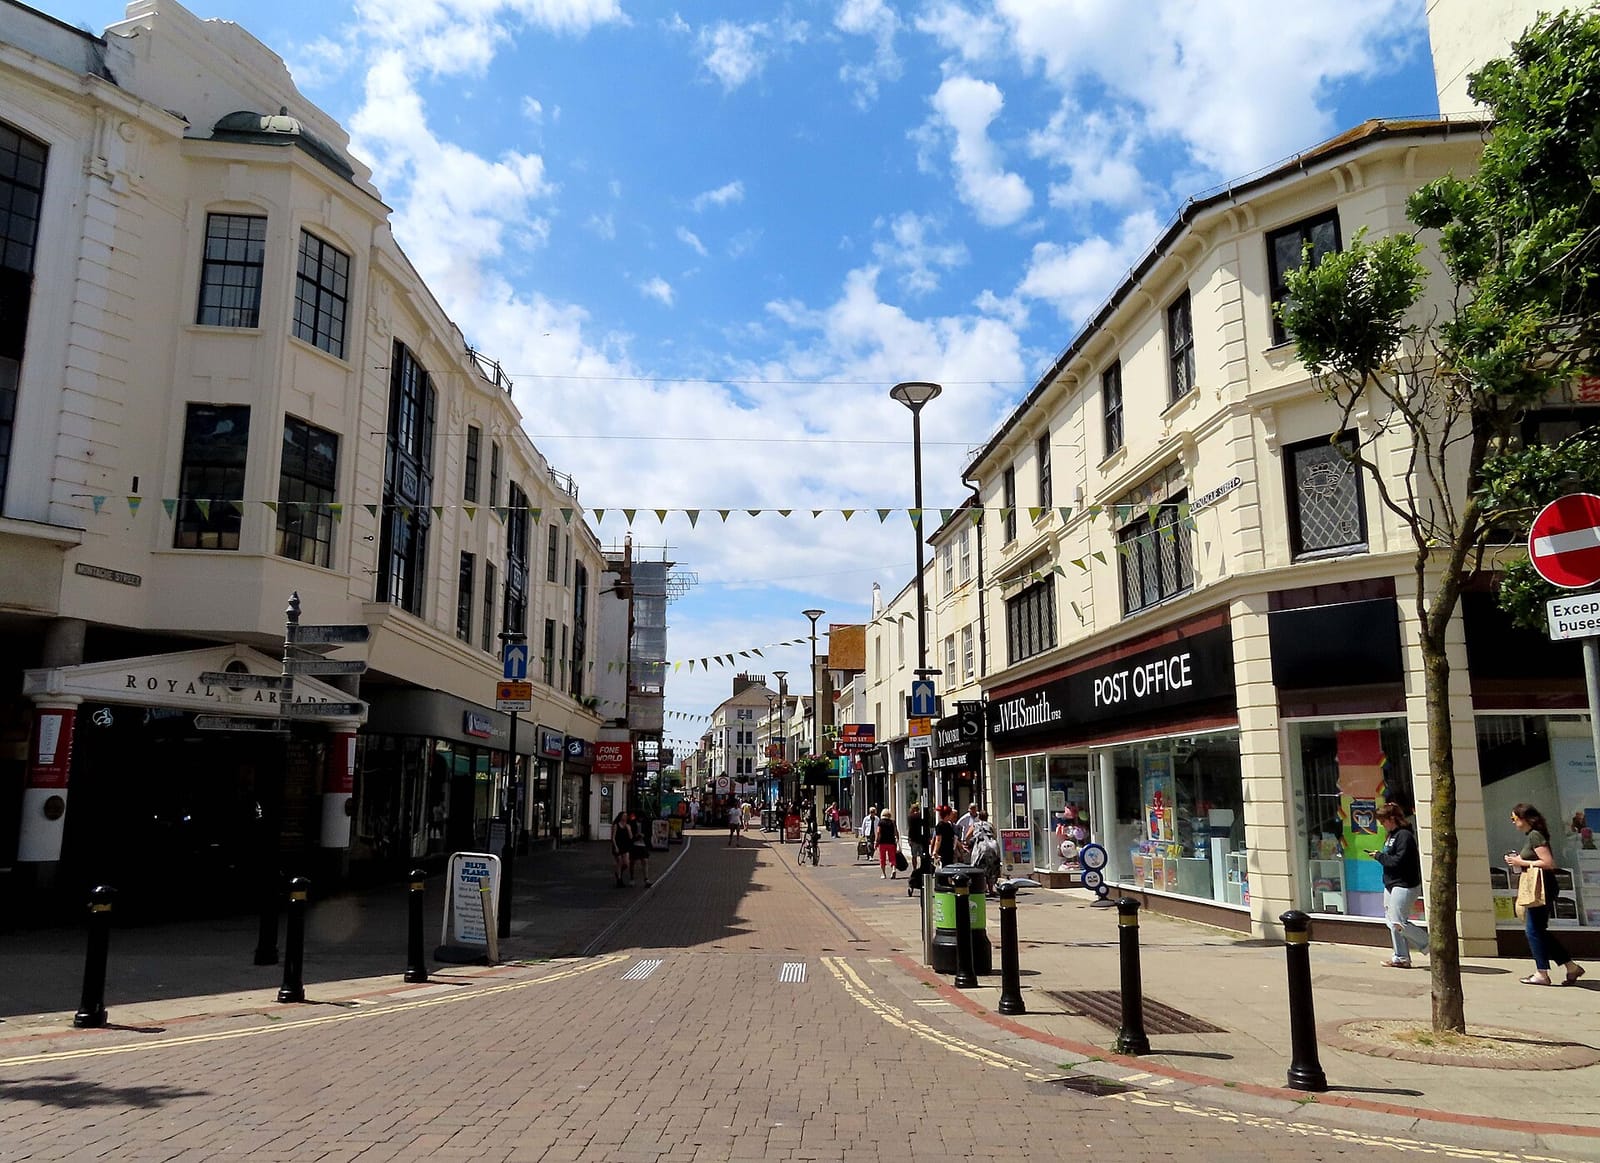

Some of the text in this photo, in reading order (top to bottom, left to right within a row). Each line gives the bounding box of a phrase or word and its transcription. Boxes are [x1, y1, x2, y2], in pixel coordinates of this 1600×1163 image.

[1553, 602, 1600, 617] Excep
[126, 674, 216, 697] ROYAL
[1094, 652, 1193, 707] POST OFFICE
[999, 691, 1051, 732] WHSmith
[1050, 709, 1062, 720] 1792
[962, 711, 979, 736] S
[595, 754, 623, 763] WORLD
[600, 746, 620, 754] FONE
[462, 868, 489, 876] FLAME
